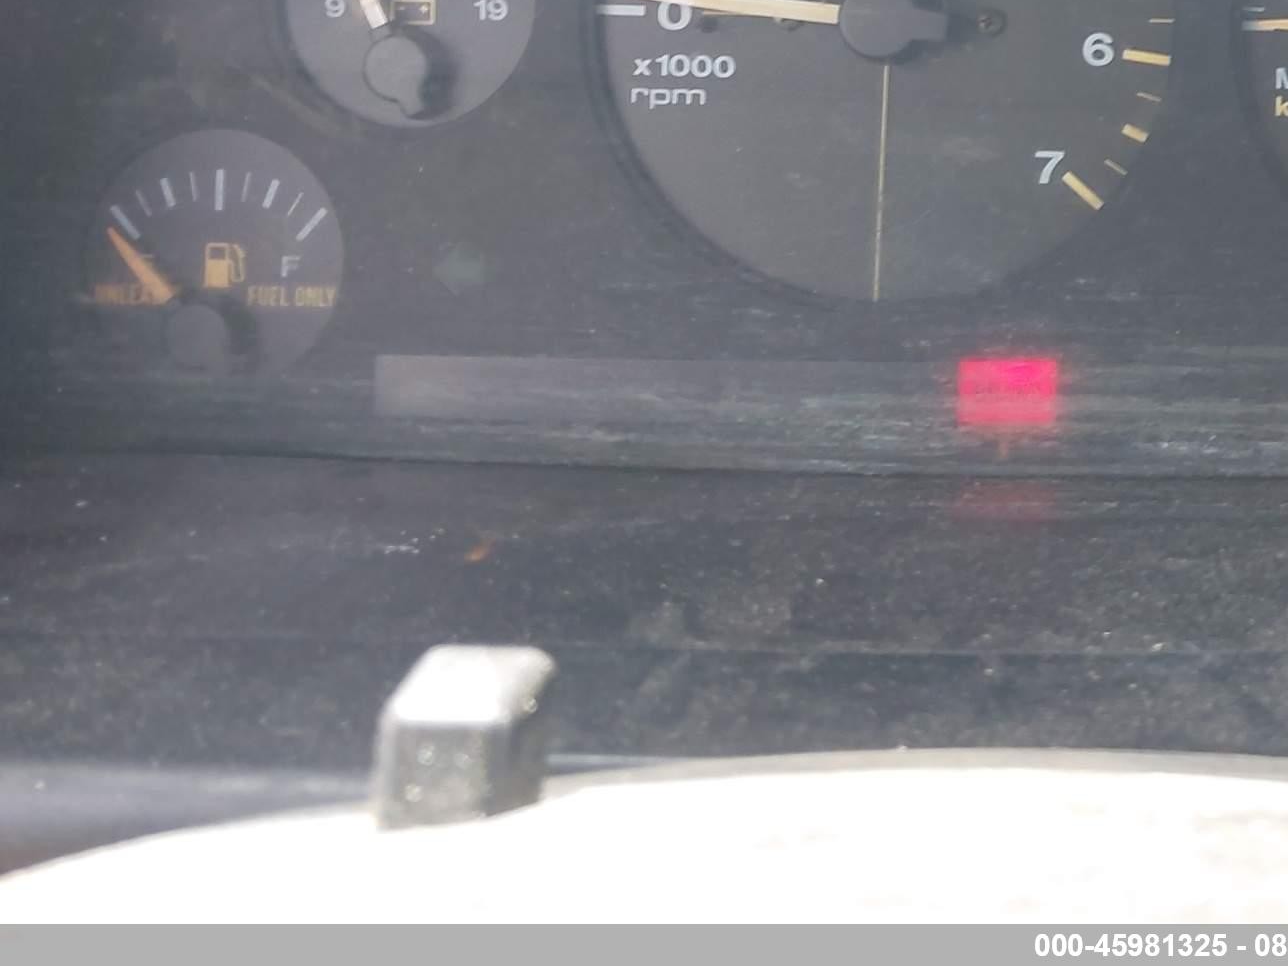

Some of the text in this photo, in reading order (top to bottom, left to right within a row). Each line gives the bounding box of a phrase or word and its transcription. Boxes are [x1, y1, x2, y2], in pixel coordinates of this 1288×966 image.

[657, 0, 692, 30] 0
[1082, 32, 1114, 66] 6
[632, 54, 736, 78] x1000
[630, 87, 707, 110] rpm
[1034, 150, 1065, 184] 7
[281, 256, 301, 278] F
[249, 285, 290, 307] FUEL
[295, 285, 337, 307] ONLY
